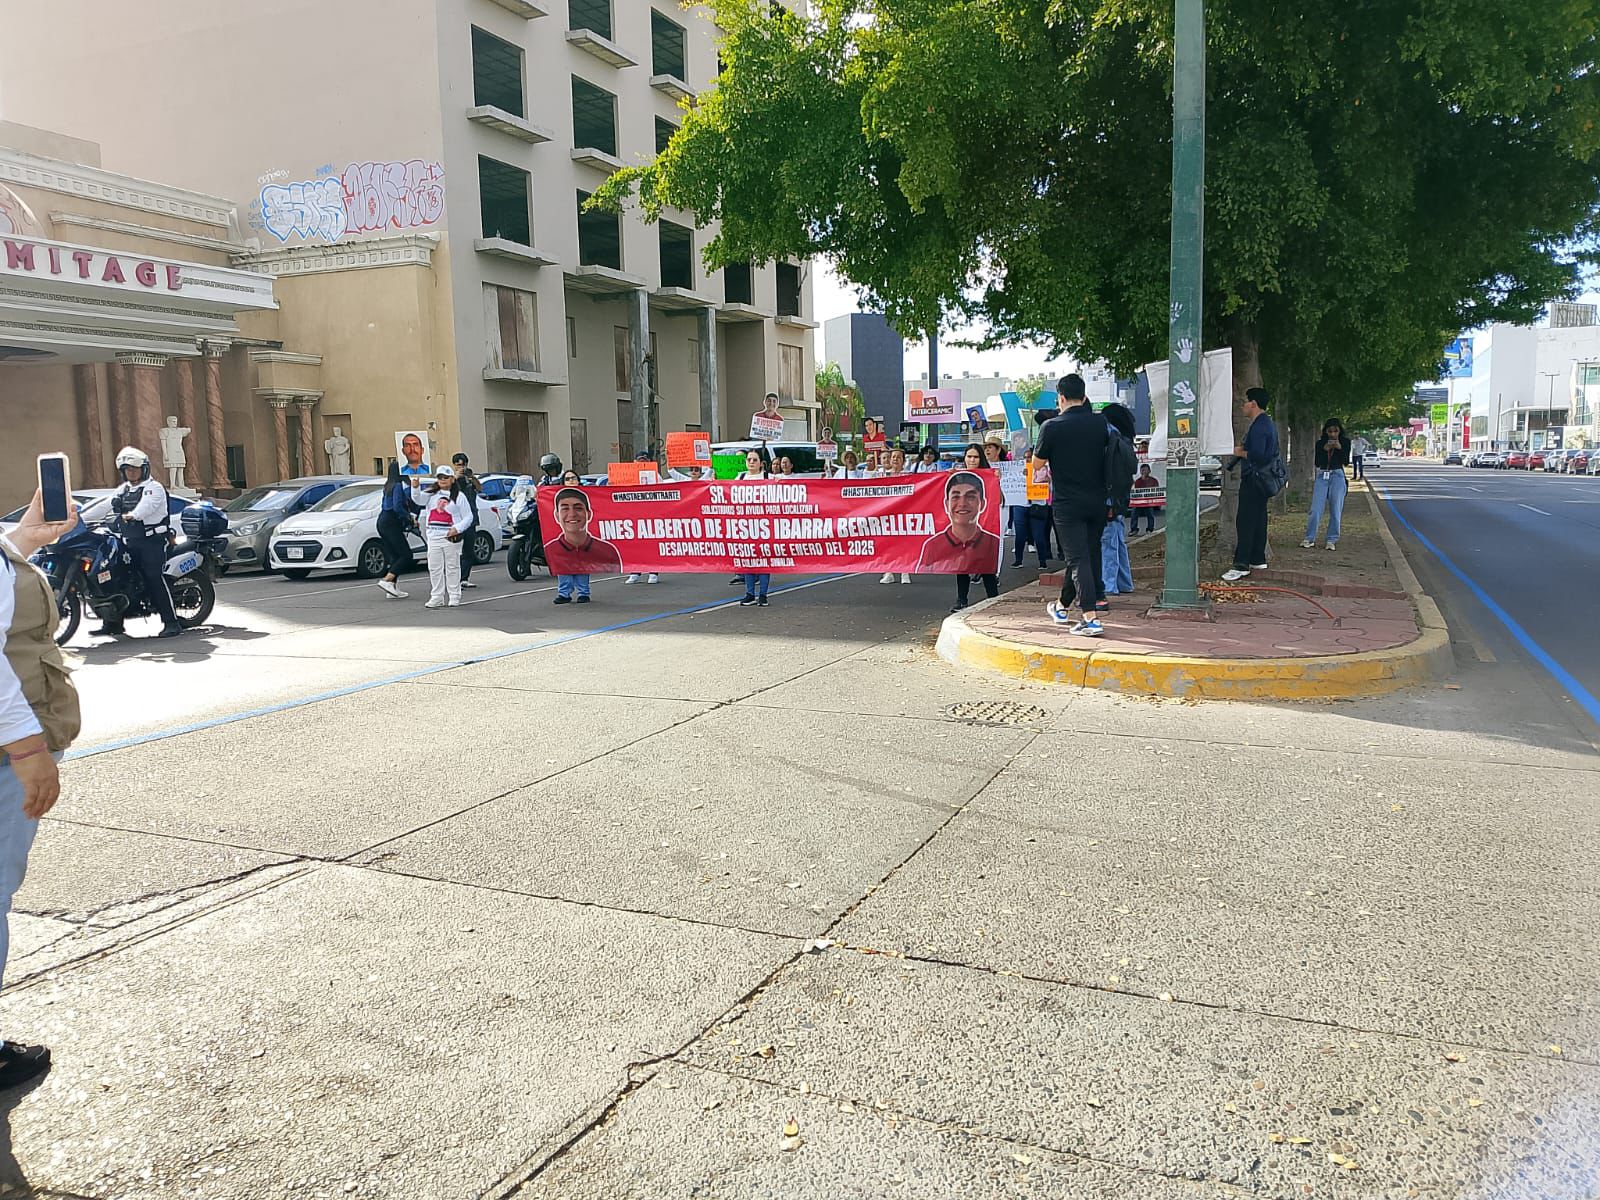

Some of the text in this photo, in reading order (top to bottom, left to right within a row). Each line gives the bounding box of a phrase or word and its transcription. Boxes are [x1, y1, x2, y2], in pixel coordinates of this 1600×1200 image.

[3, 240, 183, 290] MITAGE
[613, 492, 679, 501] #HASTAENCONTRARTE
[709, 484, 807, 504] SR. GOBERNADOR
[843, 486, 913, 497] #HASTAENCONTRARTE
[746, 505, 765, 515] AYUDA
[766, 505, 781, 515] PARA
[782, 504, 813, 515] LOCALIZAR
[814, 504, 819, 514] A
[598, 513, 936, 540] INES ALBERTO DE JESUS IBARRA BERRELLEZA
[659, 540, 875, 558] DESAPARECIDO DESDE 16 DE ENERO DEL 2025
